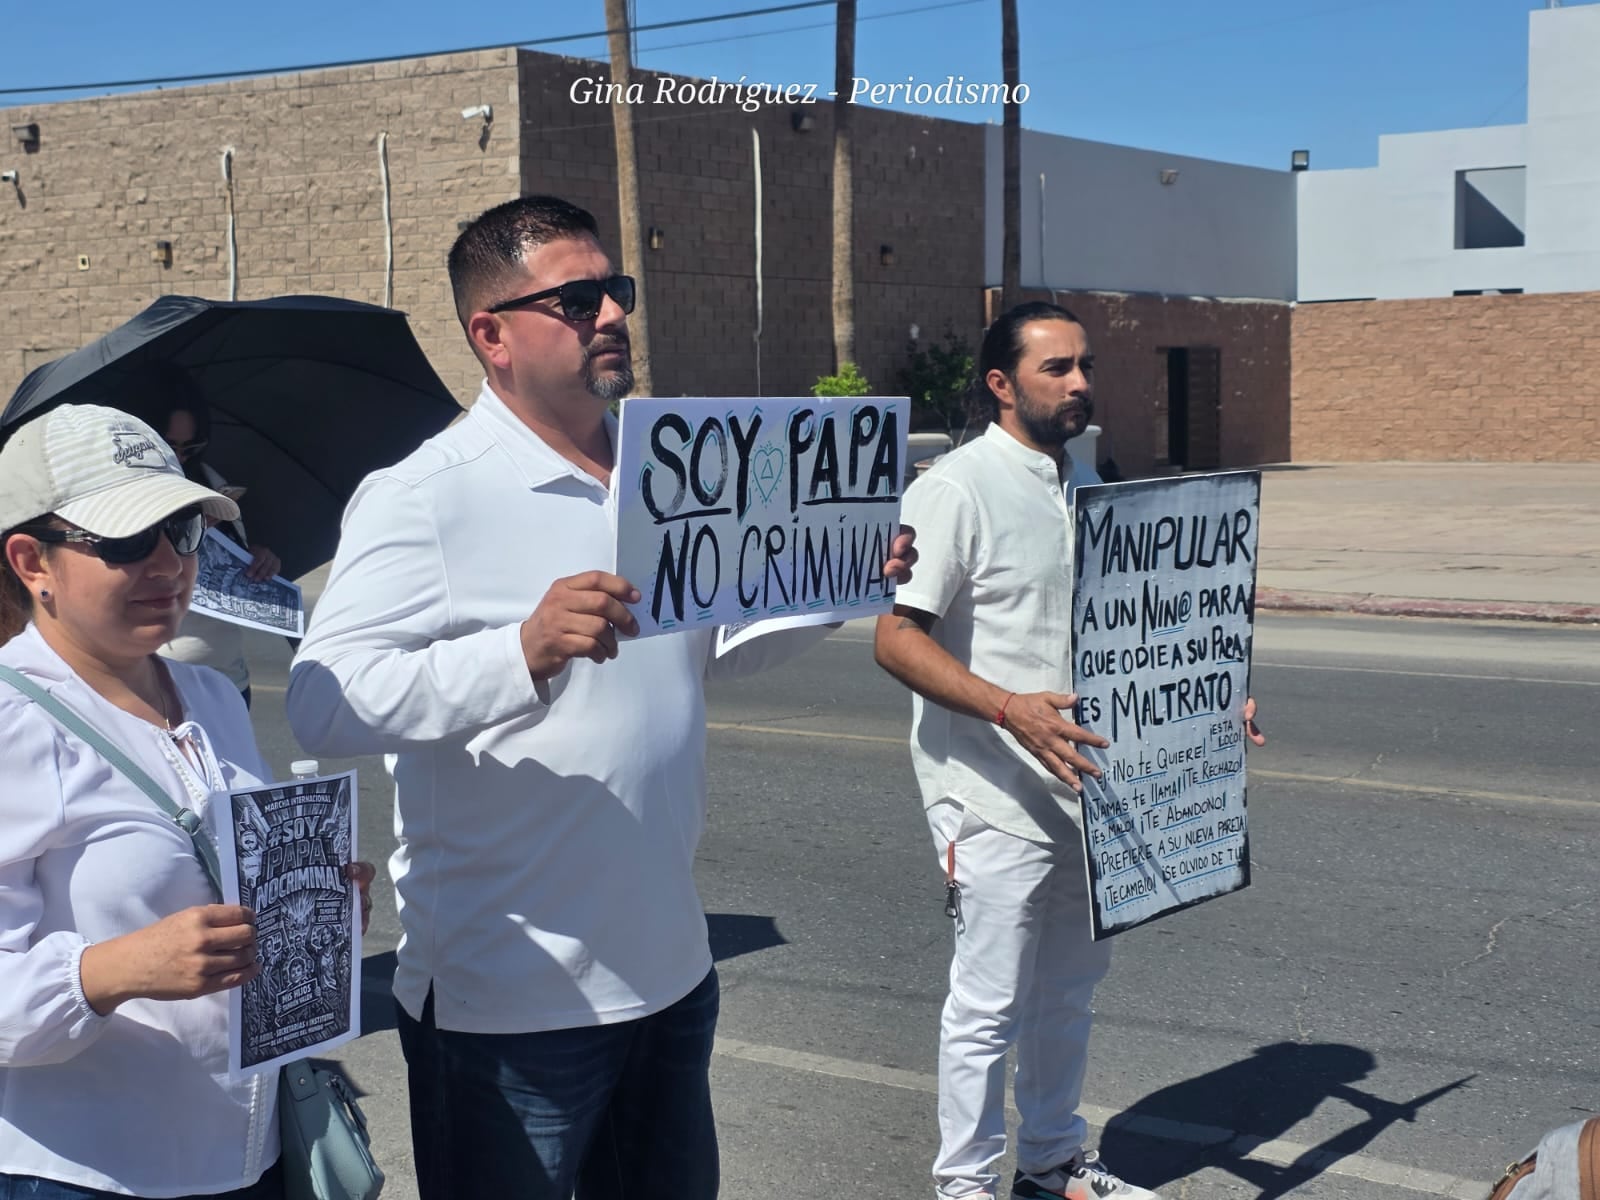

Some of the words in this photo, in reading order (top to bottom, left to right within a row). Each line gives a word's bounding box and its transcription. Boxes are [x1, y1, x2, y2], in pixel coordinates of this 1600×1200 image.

[641, 413, 763, 522] SOY
[788, 406, 899, 514] PAPA
[1078, 505, 1252, 578] MANIPULAR
[651, 520, 721, 624] NO
[1081, 597, 1098, 634] A
[1104, 597, 1136, 631] UN
[1199, 584, 1249, 618] PARA
[1081, 650, 1116, 680] QUE
[1119, 643, 1169, 674] ODIE
[1171, 643, 1183, 670] A
[1187, 637, 1208, 665] SU
[1080, 696, 1101, 724] ES
[1111, 671, 1232, 743] MALTRATO
[1157, 737, 1206, 769] QUIERE!
[265, 799, 289, 813] MARCHA
[290, 794, 331, 806] INTERNACIONAL
[268, 816, 320, 847] #SOY
[1158, 841, 1166, 856] A
[1168, 837, 1182, 852] SU
[1185, 826, 1214, 847] NUEVA
[267, 838, 327, 880] PAPA
[1179, 856, 1209, 875] OLVIDO
[1212, 850, 1224, 866] DE
[282, 992, 293, 1003] MIS
[293, 984, 311, 998] HIJOS
